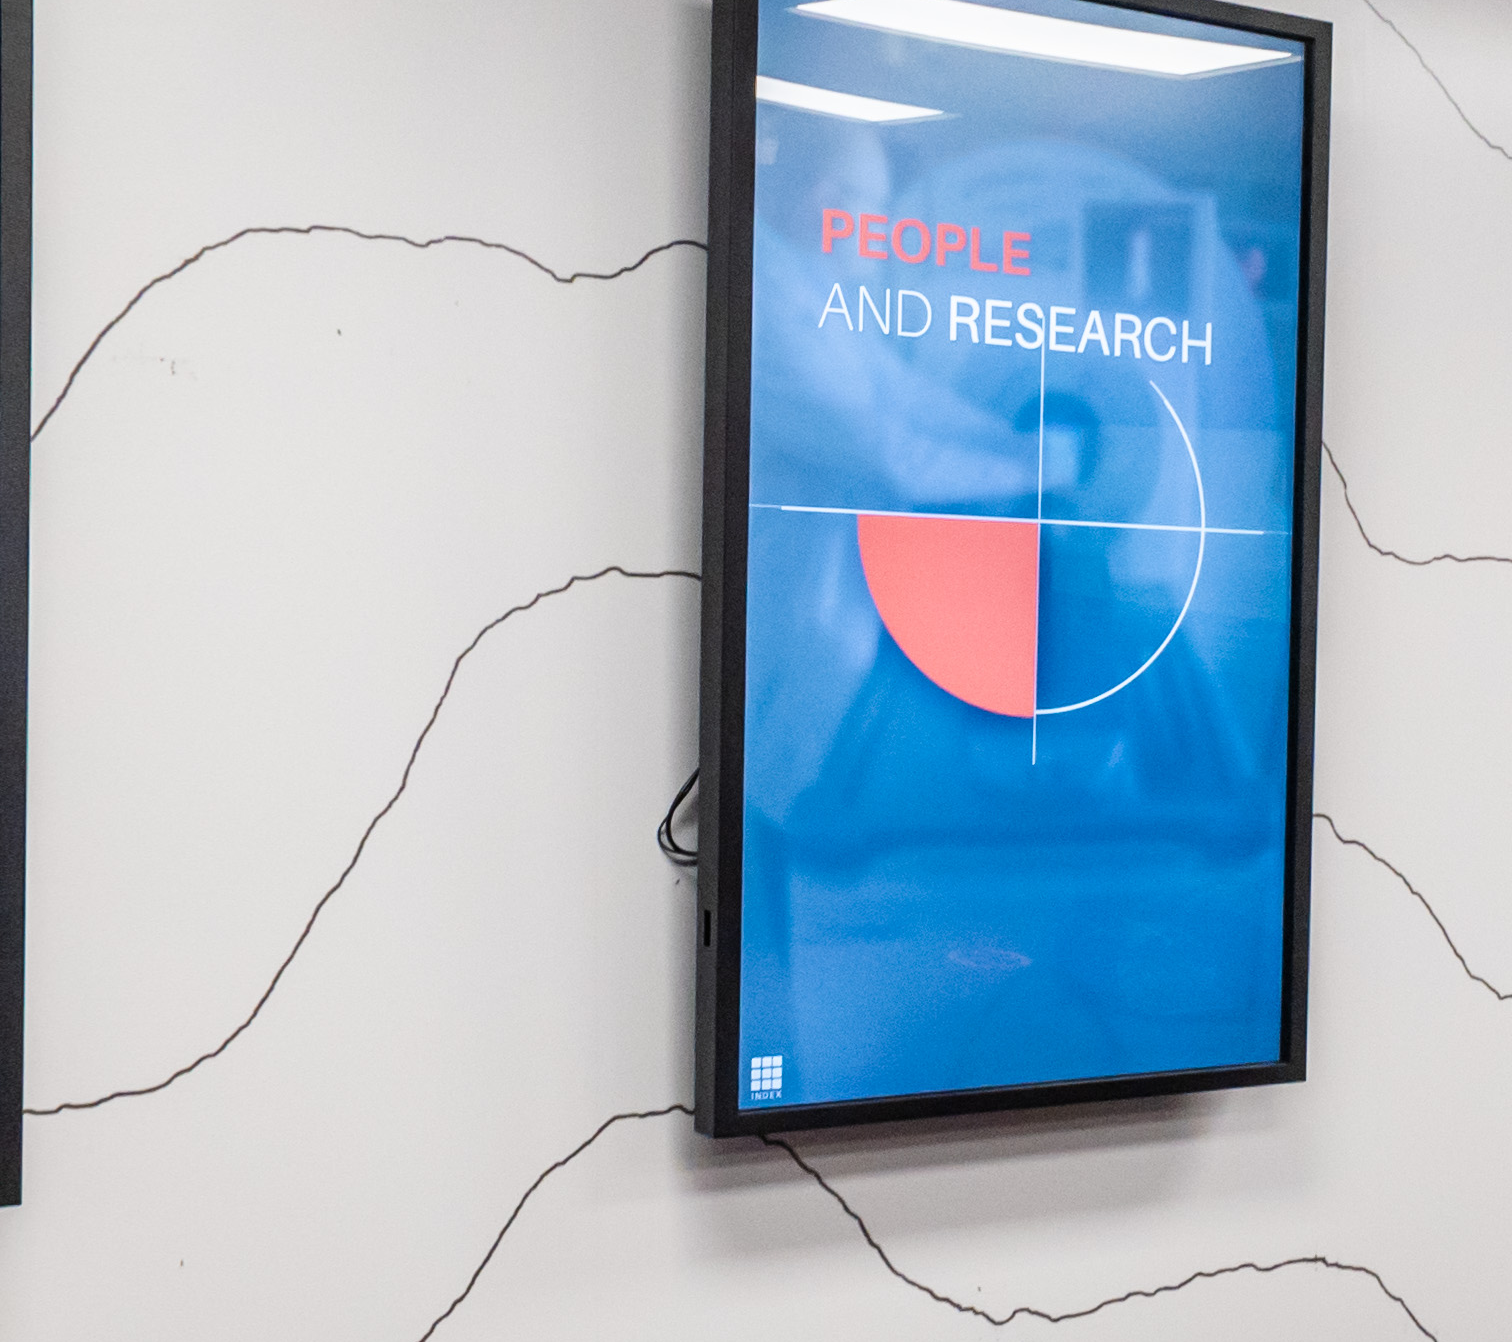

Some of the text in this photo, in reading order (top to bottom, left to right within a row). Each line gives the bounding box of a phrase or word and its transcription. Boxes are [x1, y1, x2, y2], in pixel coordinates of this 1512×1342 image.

[822, 208, 1032, 276] PEOPLE
[818, 282, 1212, 365] AND RESEARCH
